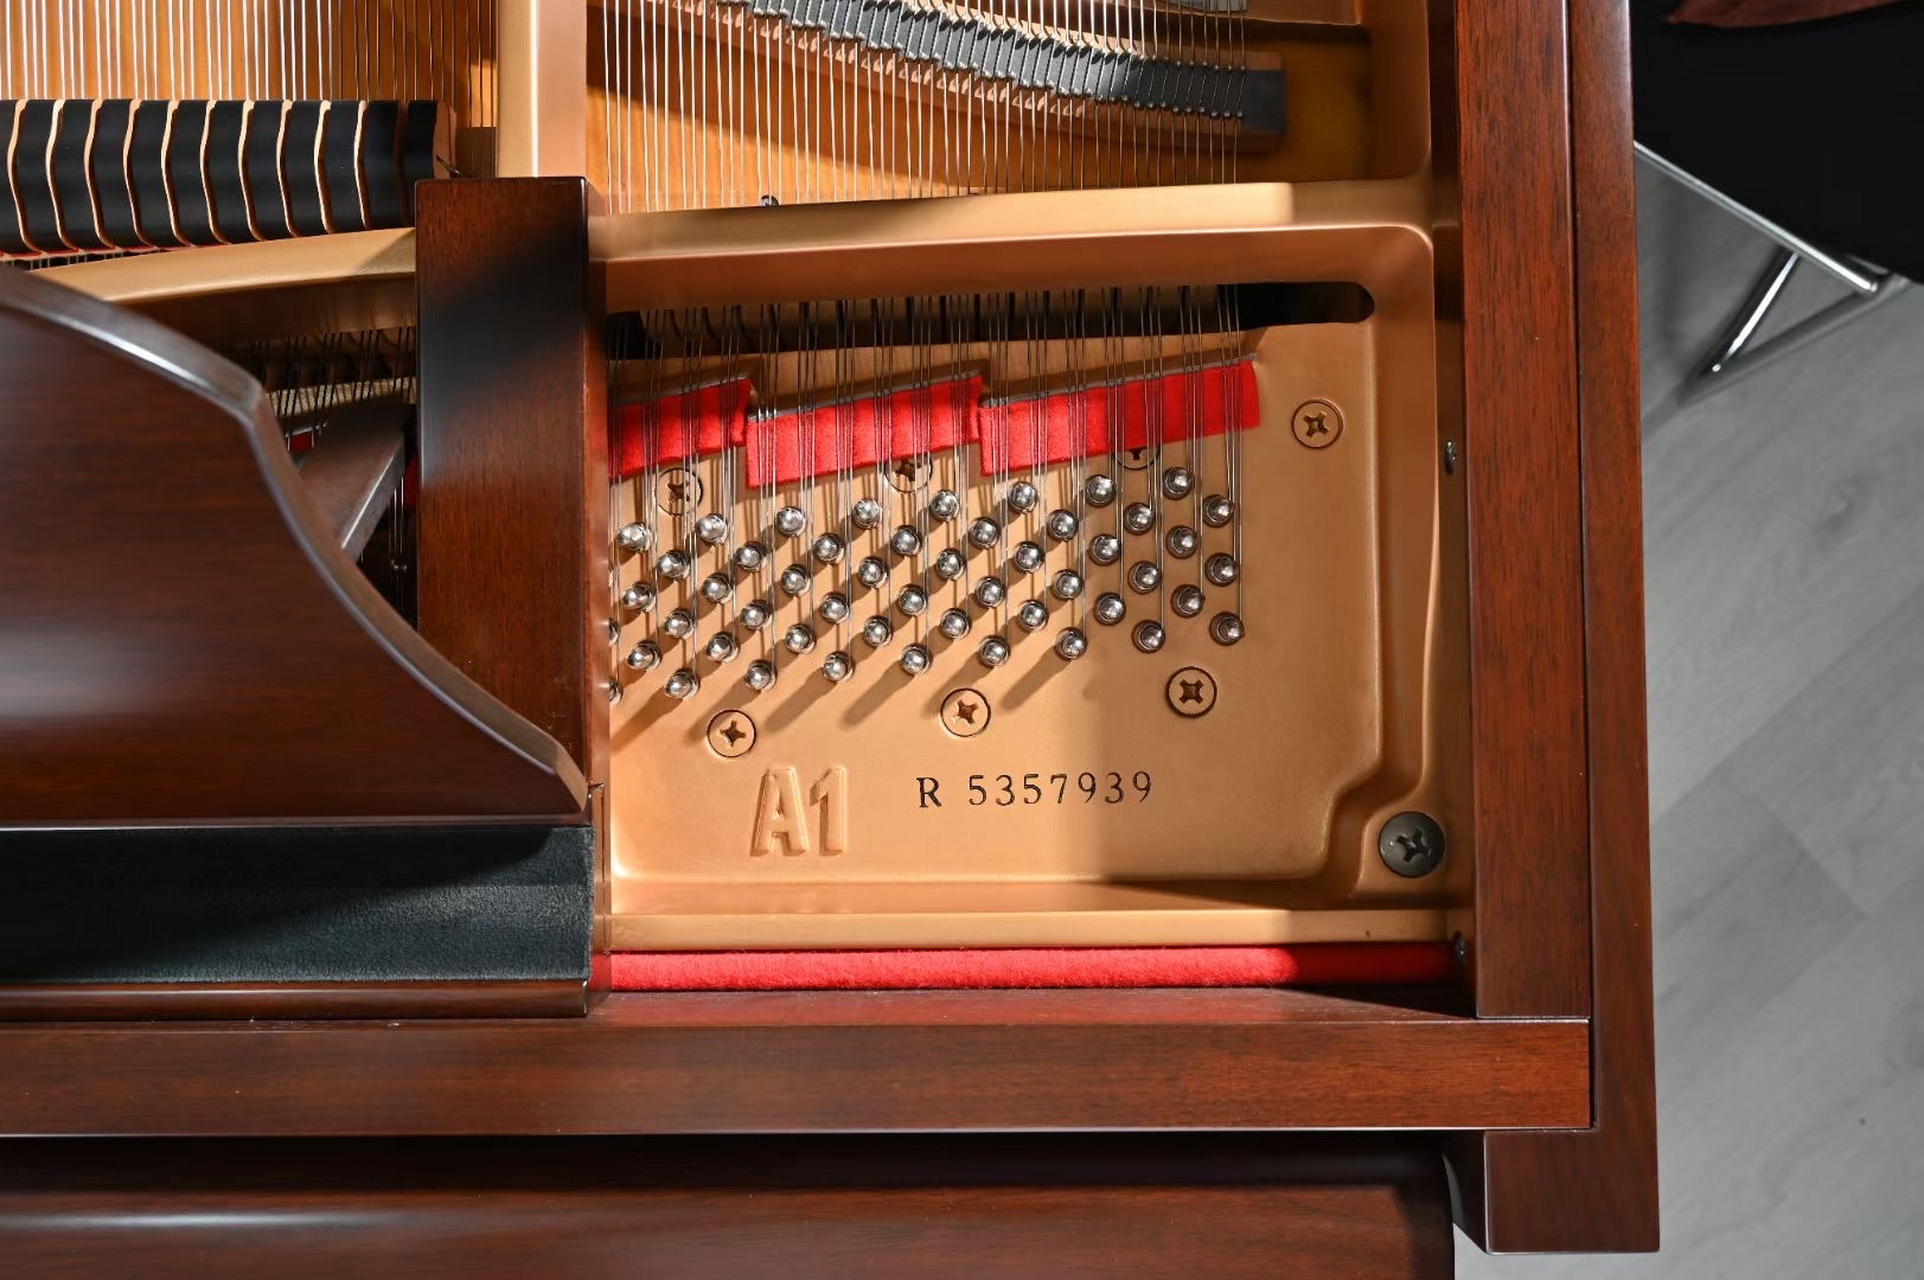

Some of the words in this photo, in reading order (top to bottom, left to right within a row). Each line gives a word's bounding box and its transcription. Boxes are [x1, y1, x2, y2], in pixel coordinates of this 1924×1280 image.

[749, 764, 849, 857] A1
[916, 776, 943, 808] R
[968, 770, 1152, 806] 5357939
